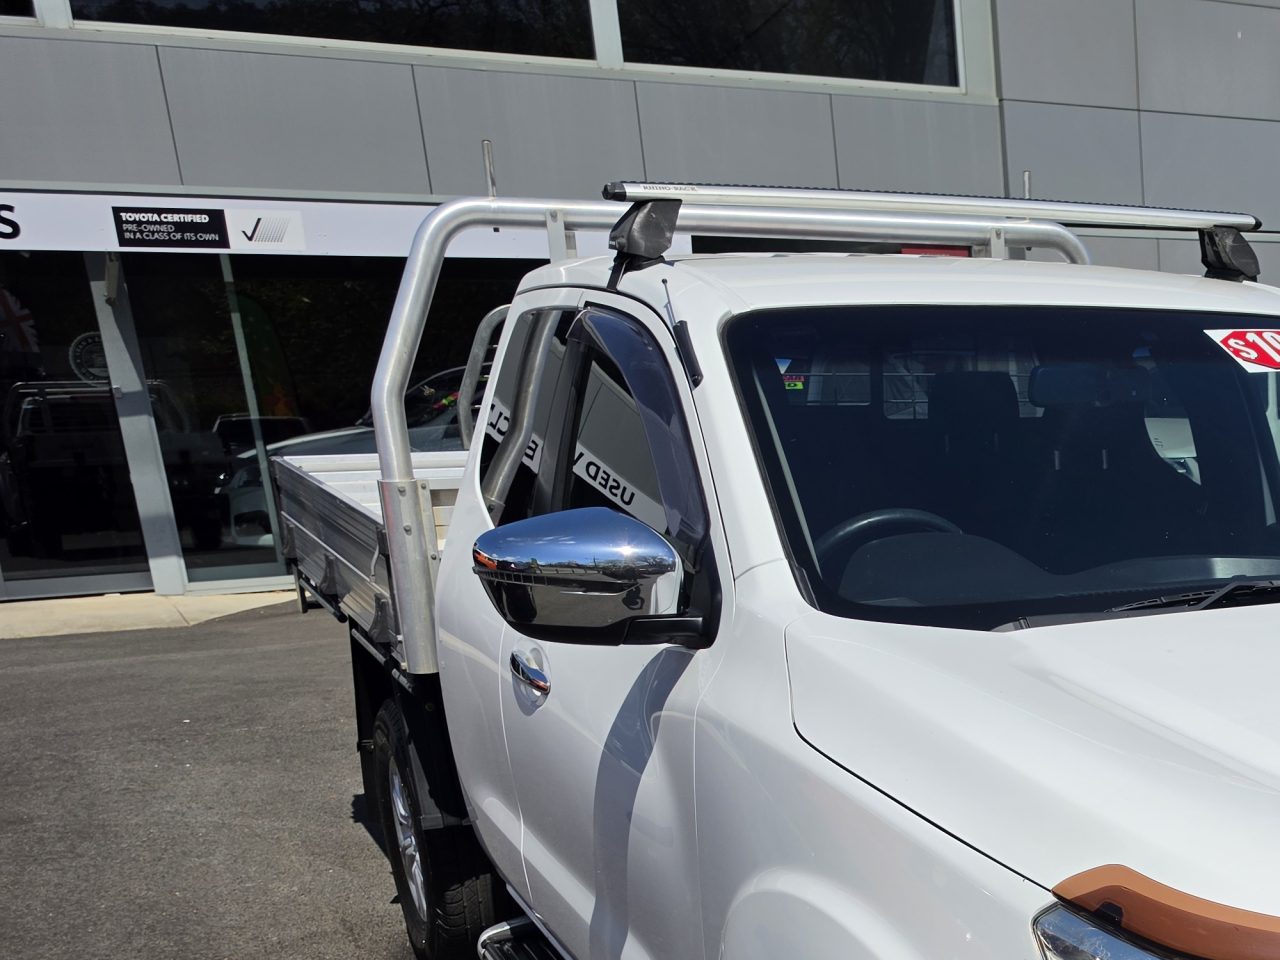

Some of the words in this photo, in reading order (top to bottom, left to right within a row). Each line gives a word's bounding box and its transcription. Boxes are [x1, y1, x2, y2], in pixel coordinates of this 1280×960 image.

[120, 212, 160, 222] TOYOTA
[160, 213, 209, 223] CERTIFIED
[122, 223, 175, 232] PRE-OWNED
[143, 232, 169, 240] CLASS
[170, 232, 182, 240] OF
[184, 233, 196, 241] ITS
[197, 233, 219, 241] OWN
